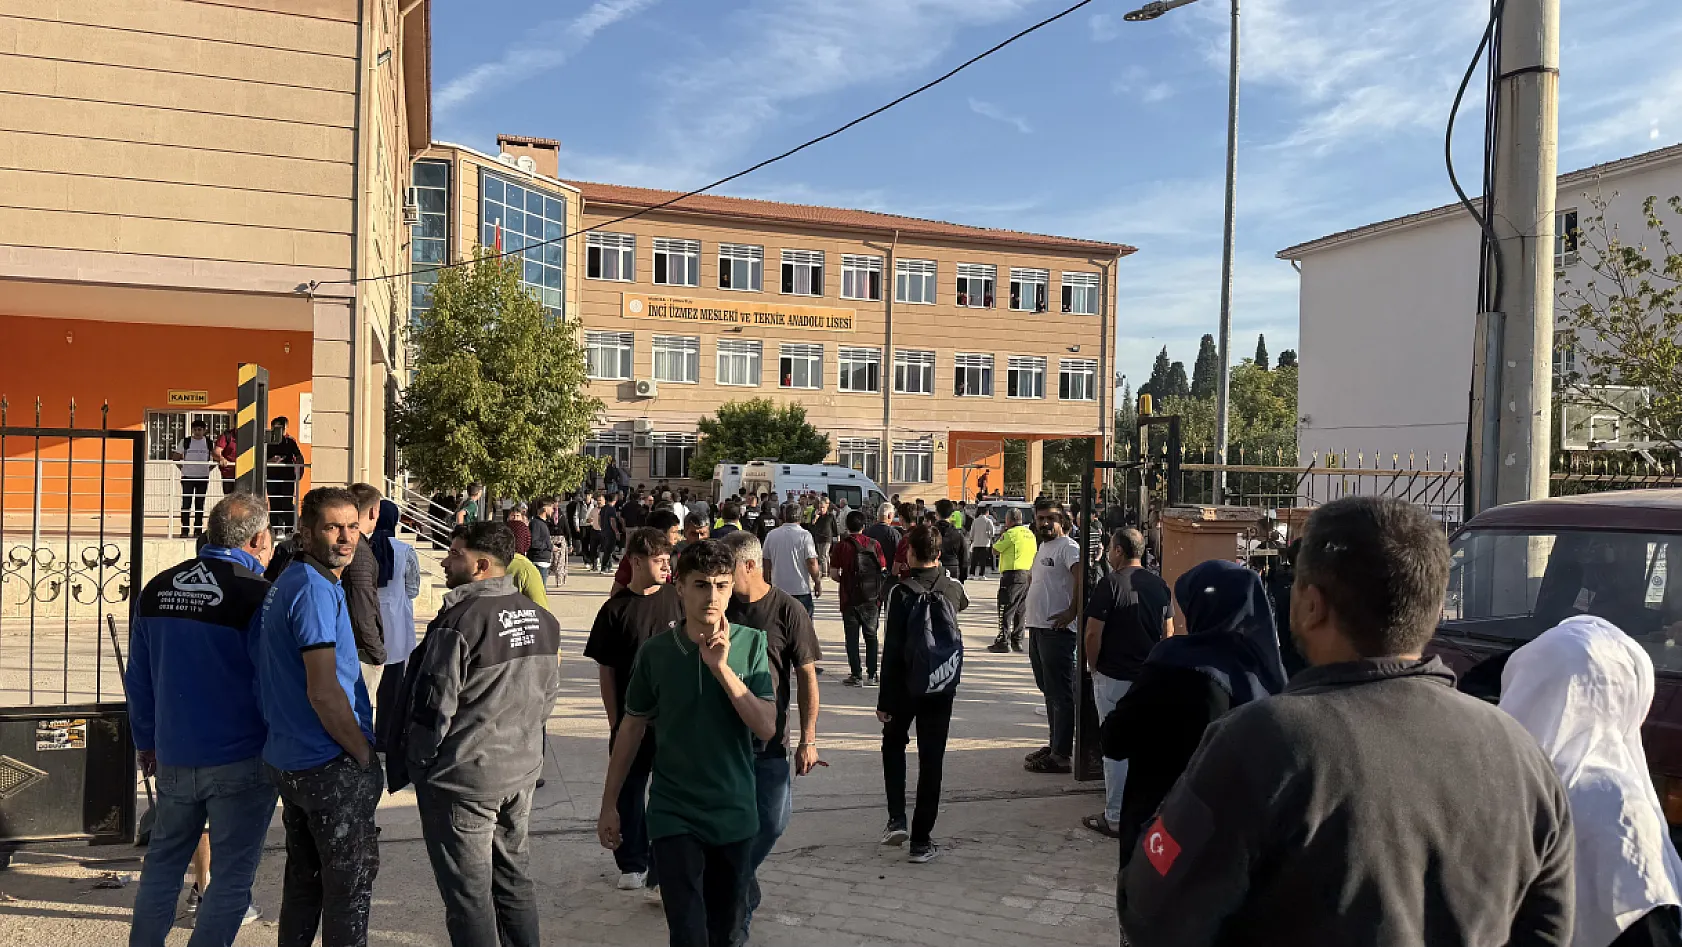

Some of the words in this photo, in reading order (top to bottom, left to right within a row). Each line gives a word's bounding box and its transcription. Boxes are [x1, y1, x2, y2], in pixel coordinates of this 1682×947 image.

[647, 302, 667, 317] İNCİ
[669, 303, 698, 320] ÜZMEZ
[699, 308, 739, 322] MESLEKİ
[740, 312, 751, 323] VE
[753, 311, 785, 325] TEKNİK
[787, 314, 825, 328] ANADOLU
[826, 314, 852, 329] LİSESİ
[929, 650, 960, 688] NIKE
